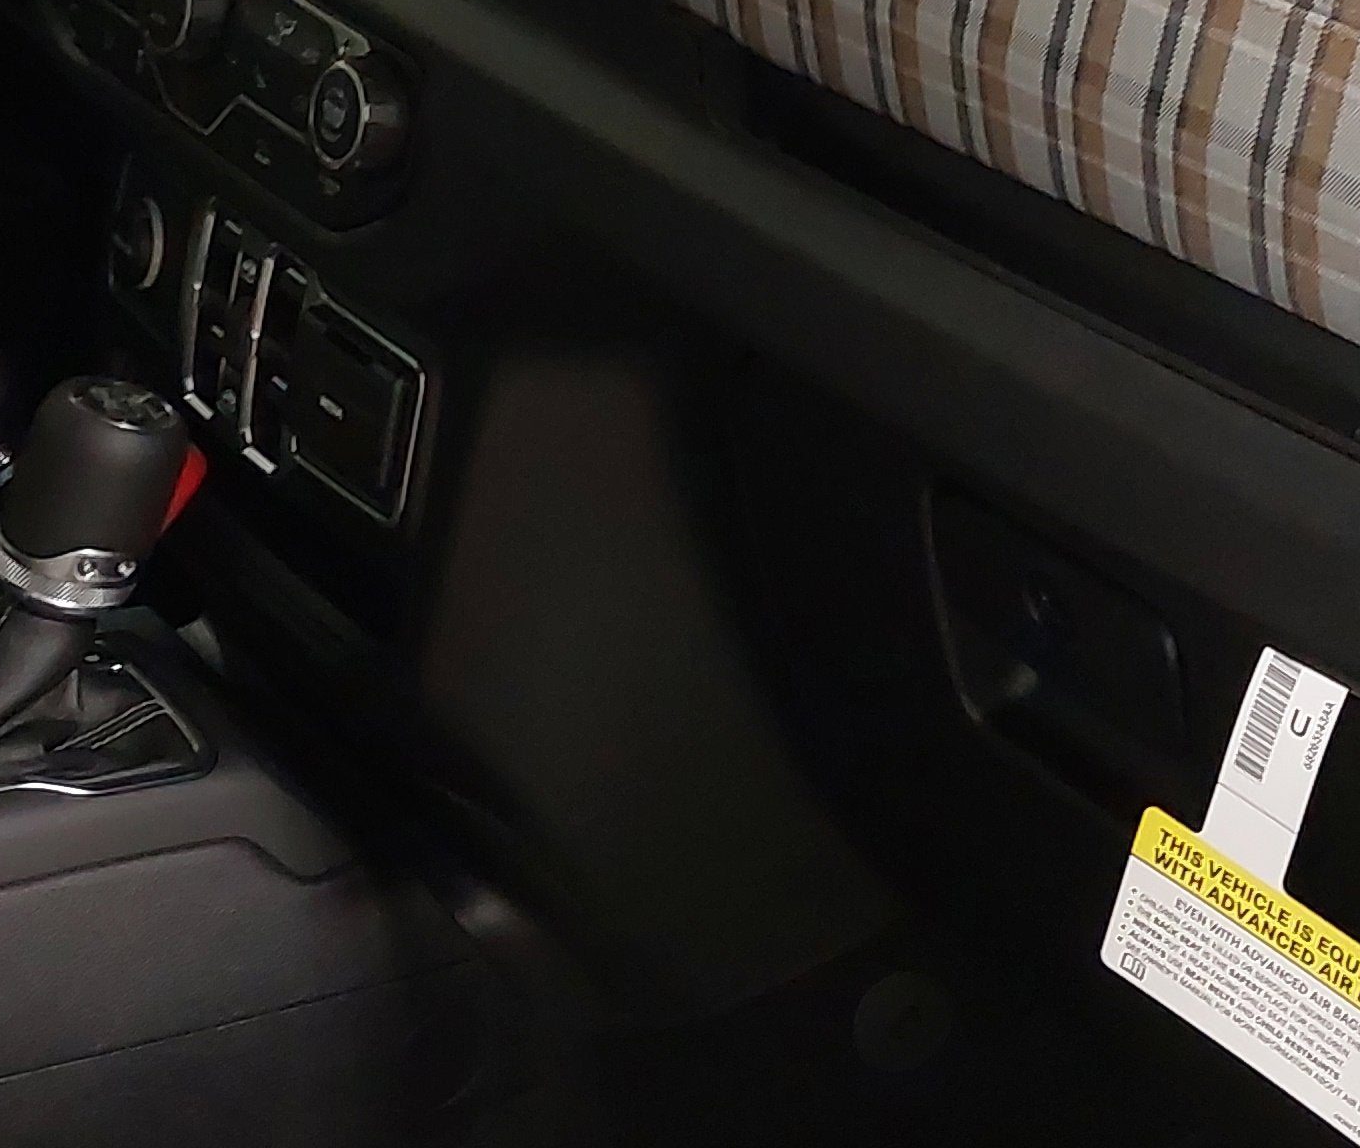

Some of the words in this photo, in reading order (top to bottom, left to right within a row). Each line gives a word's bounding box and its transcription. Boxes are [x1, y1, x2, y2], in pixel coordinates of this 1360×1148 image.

[1289, 708, 1313, 738] U
[1132, 917, 1161, 942] NEVER
[1151, 847, 1209, 897] WITH
[1209, 886, 1314, 969] ADVANCED
[1318, 960, 1353, 995] AIR
[1158, 828, 1202, 869] THIS
[1206, 861, 1290, 929] VEHICLE
[1293, 920, 1313, 944] IS
[1128, 928, 1165, 960] ALWAYS
[1184, 967, 1205, 987] SEAT
[1208, 984, 1234, 1007] BELTS
[1255, 1017, 1282, 1041] CHILD
[1153, 917, 1177, 938] BACK
[1180, 935, 1200, 954] SEAT
[1212, 957, 1226, 972] THE
[1229, 969, 1261, 996] SAFEST
[1290, 1011, 1305, 1027] FOR
[1175, 897, 1206, 927] EVEN
[1209, 921, 1240, 950] WITH
[1242, 944, 1307, 996] ADVANCED
[1310, 990, 1330, 1012] AIR
[1313, 1073, 1340, 1098] ABOUT
[1342, 1094, 1356, 1109] AIR
[1334, 1028, 1344, 1040] BY
[1347, 1036, 1360, 1052] THE
